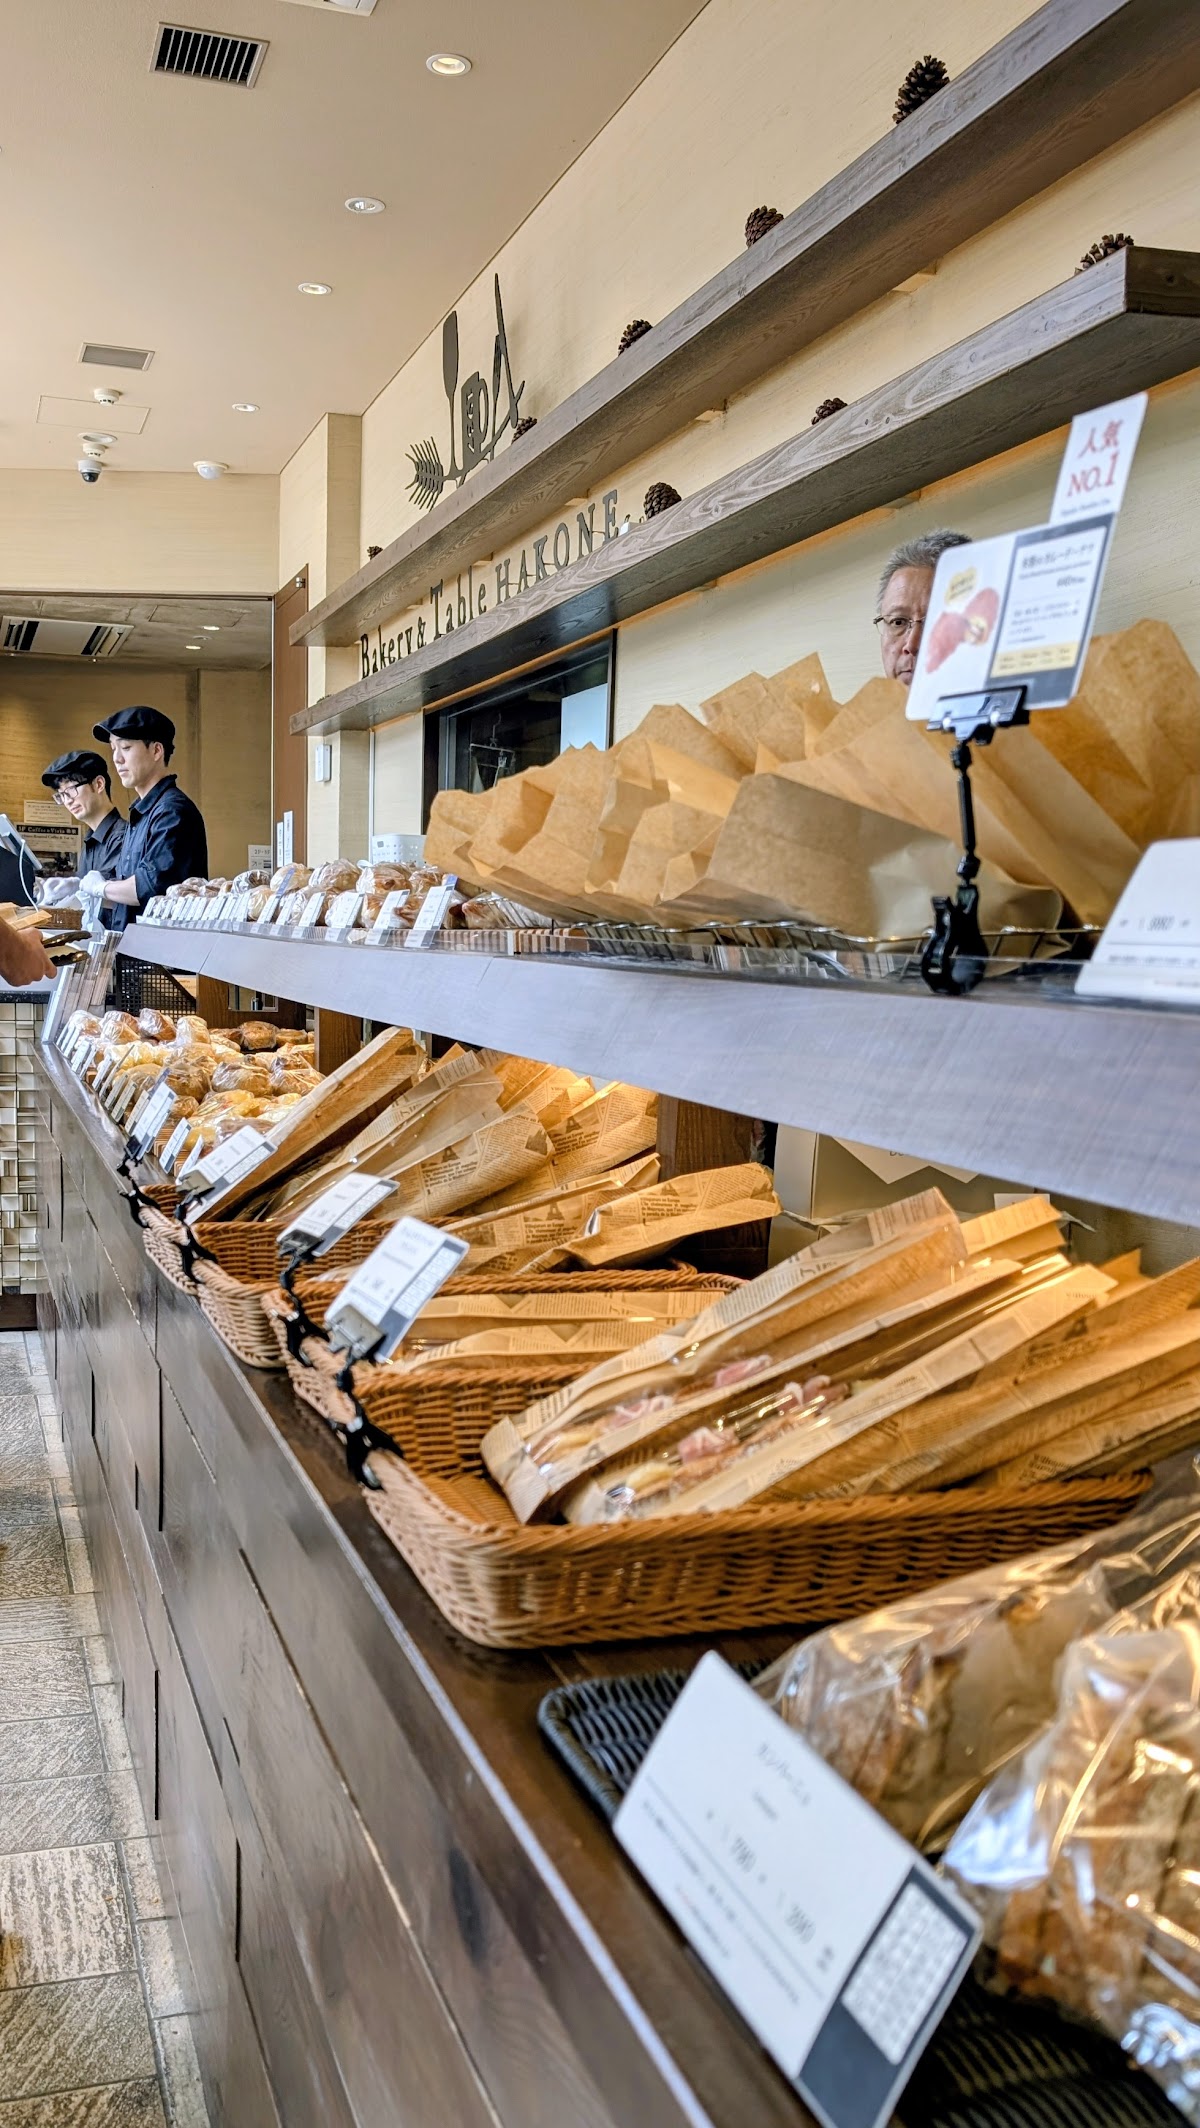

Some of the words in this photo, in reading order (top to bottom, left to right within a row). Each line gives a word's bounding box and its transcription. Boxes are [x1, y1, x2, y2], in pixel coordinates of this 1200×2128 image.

[1066, 450, 1120, 497] NO.1
[360, 624, 413, 680] Bakery
[416, 616, 428, 648] &
[430, 565, 487, 639] Table
[495, 489, 619, 606] HAKONE
